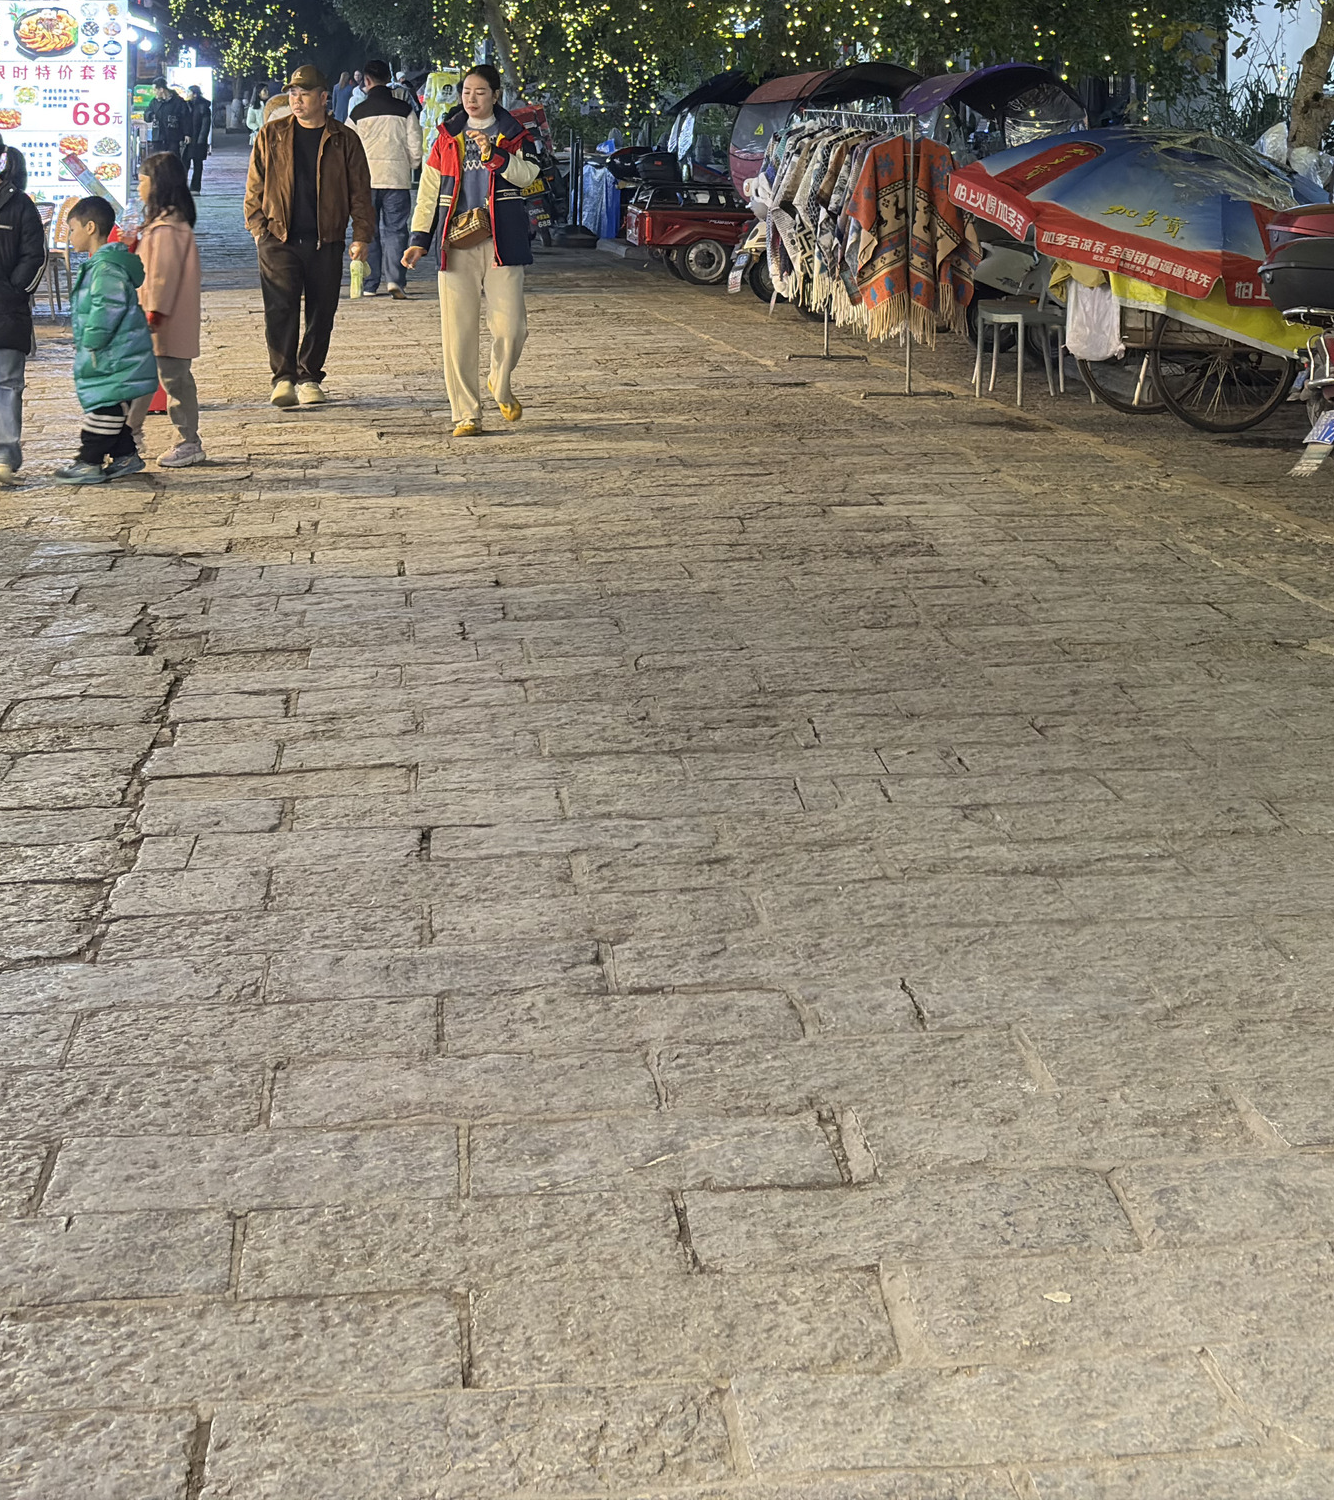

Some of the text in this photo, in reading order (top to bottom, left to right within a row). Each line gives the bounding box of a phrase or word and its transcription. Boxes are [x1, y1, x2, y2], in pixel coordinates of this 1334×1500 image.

[72, 102, 123, 126] 68元
[954, 182, 1025, 236] 怕上火喝加多宝
[1041, 230, 1212, 288] 加多宝凉茶 全国销量遥遥领先
